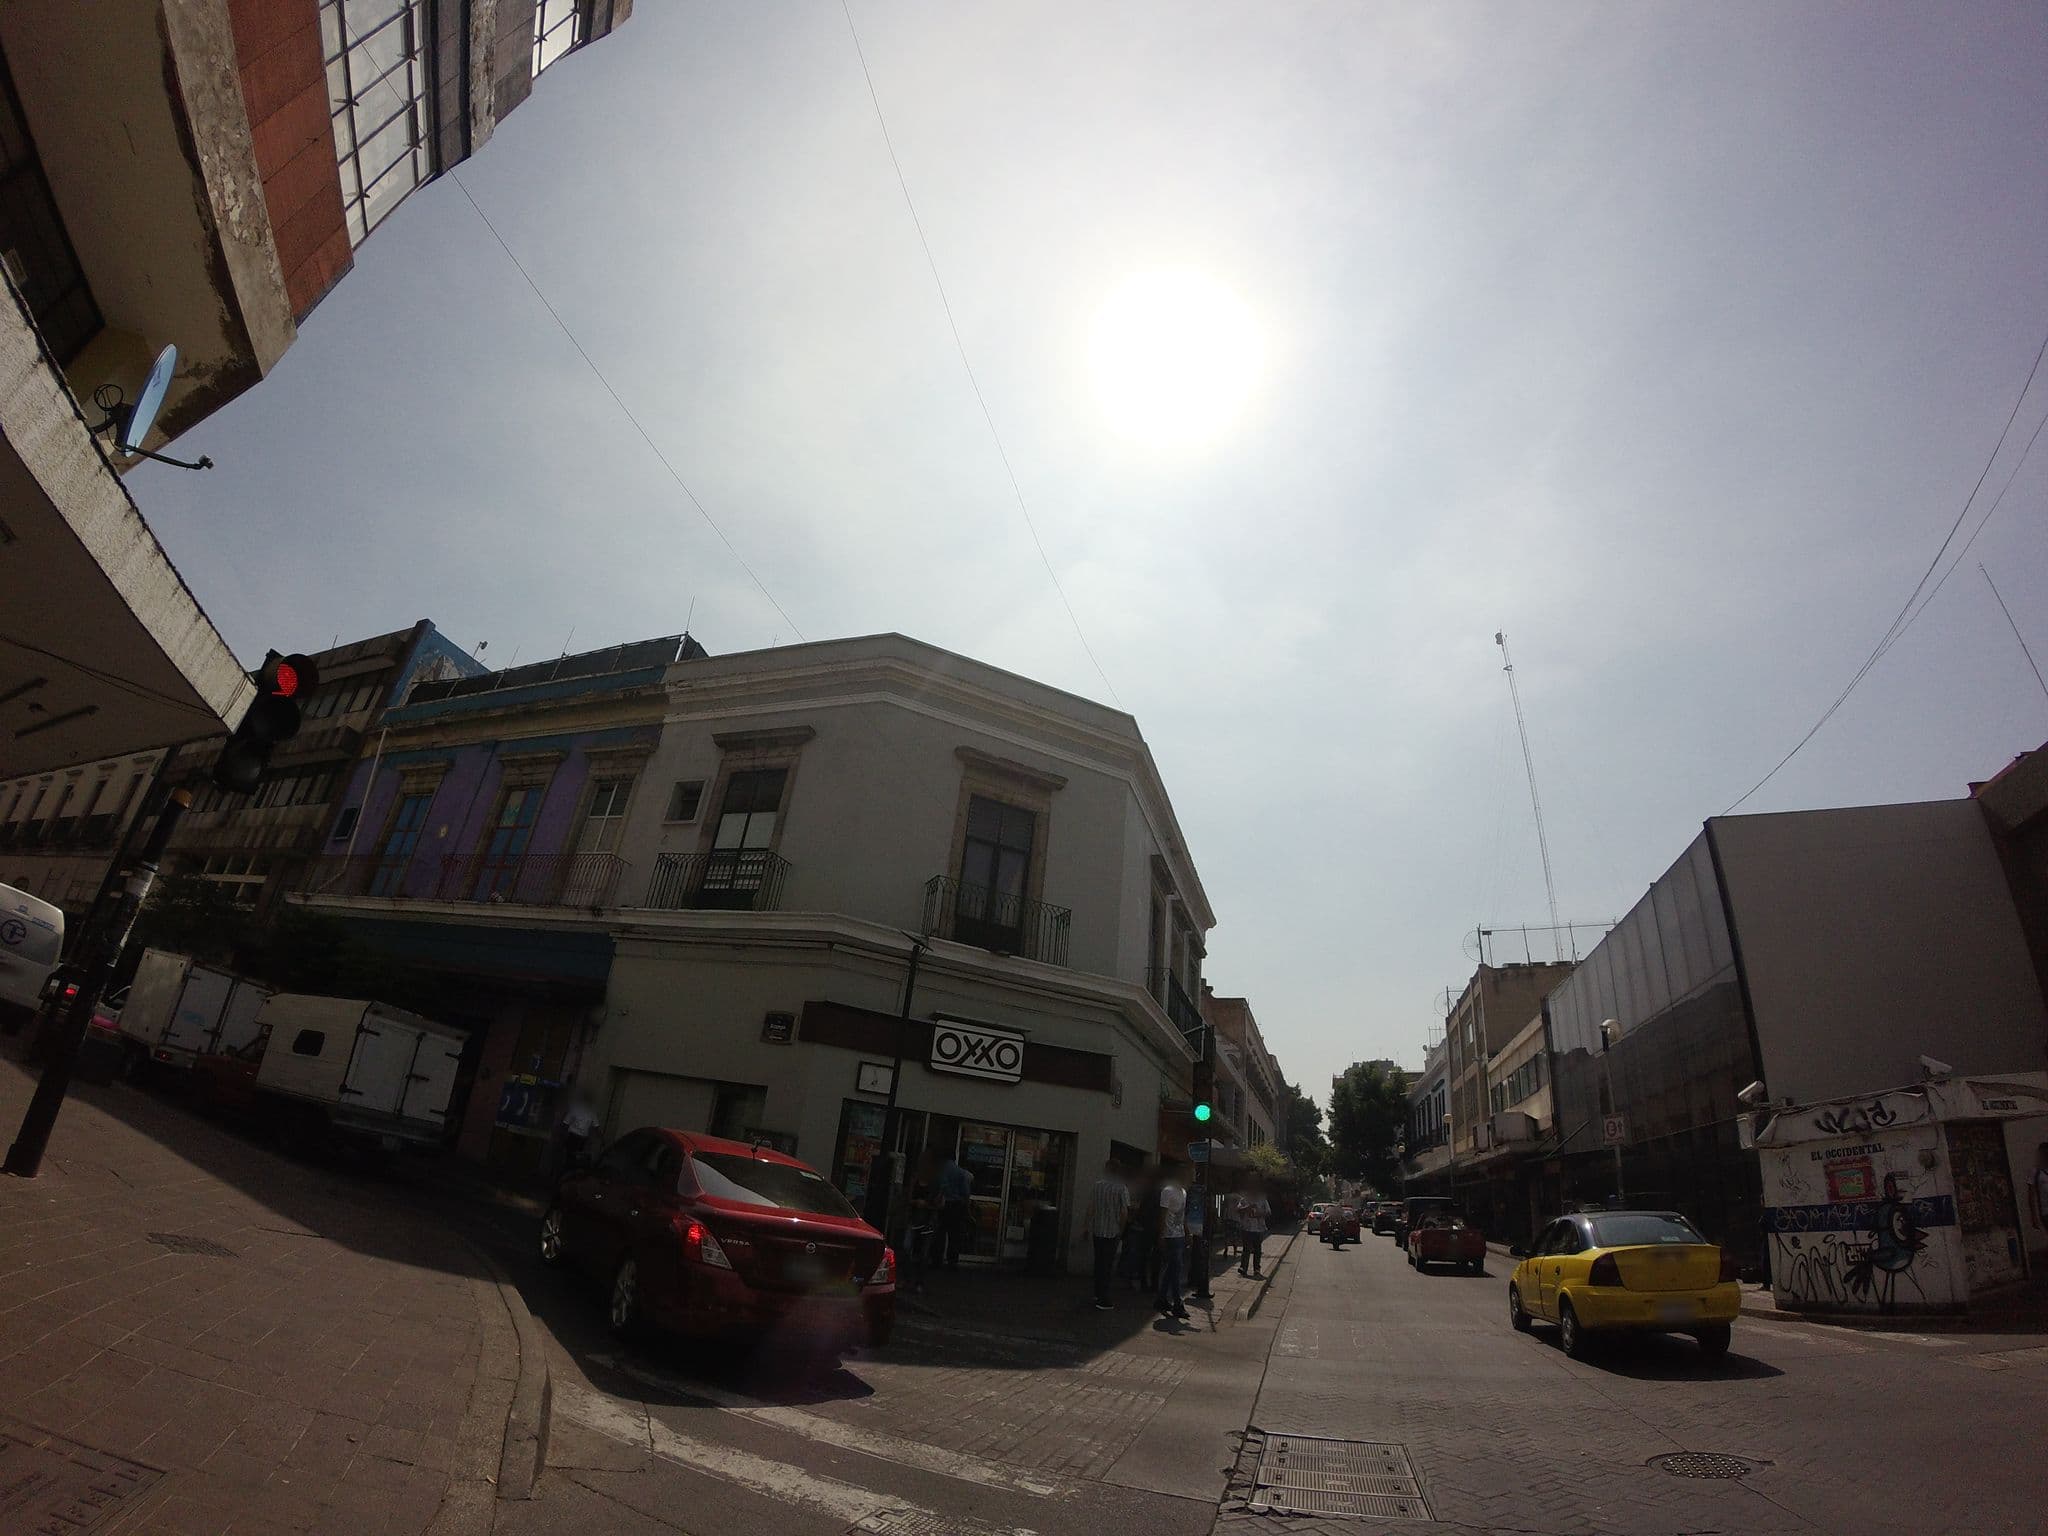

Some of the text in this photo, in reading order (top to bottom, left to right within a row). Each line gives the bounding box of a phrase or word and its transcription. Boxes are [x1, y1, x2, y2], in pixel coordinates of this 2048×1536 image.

[936, 1032, 1020, 1070] OXXO
[1811, 1143, 1885, 1161] EL OCCIDENTAL
